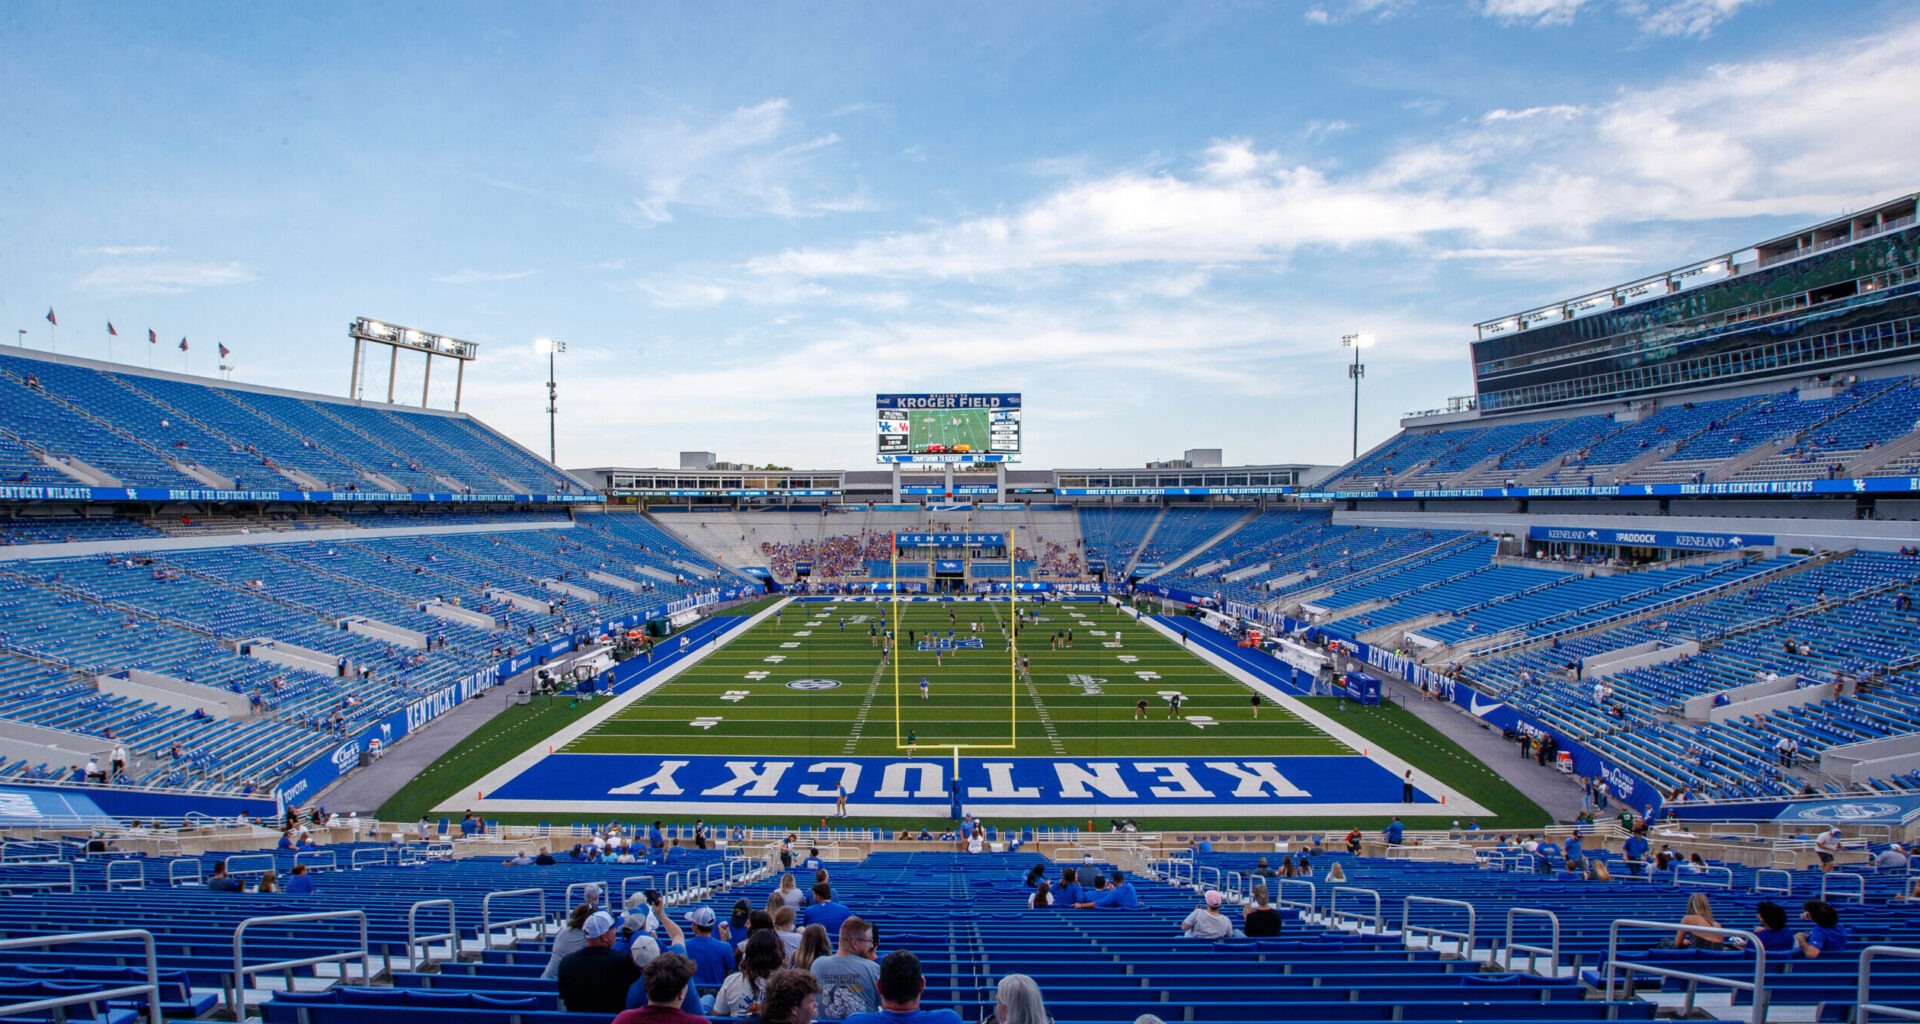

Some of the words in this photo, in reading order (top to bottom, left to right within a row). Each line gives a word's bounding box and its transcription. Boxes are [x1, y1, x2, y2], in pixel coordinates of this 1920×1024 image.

[898, 398, 955, 408] KROGER
[960, 397, 1000, 407] FIELD
[47, 487, 92, 499] WILDCATS
[1528, 488, 1542, 496] HOME
[1562, 487, 1590, 495] KENTUCKY
[1592, 486, 1619, 494] WILDCATS
[1681, 484, 1700, 494] HOME
[1701, 484, 1711, 494] OF
[1713, 483, 1727, 493] THE
[1729, 482, 1769, 492] KENTUCKY
[1771, 482, 1813, 492] WILDCATS
[170, 490, 190, 500] HOME
[191, 490, 200, 500] OF
[202, 490, 215, 500] THE
[217, 490, 248, 500] KENTUCKY
[250, 490, 280, 500] WILDCATS
[1549, 530, 1584, 540] KEENELAND
[1620, 533, 1656, 543] PADDOCK
[1676, 535, 1725, 547] KEENELAND
[1367, 644, 1409, 680] KENTUCKY
[406, 685, 456, 733] KENTUCKY
[460, 665, 499, 701] WILDCATS
[607, 759, 1312, 798] KENTUCKY
[1610, 768, 1634, 799] Kroger
[283, 778, 308, 804] TOYOTA
